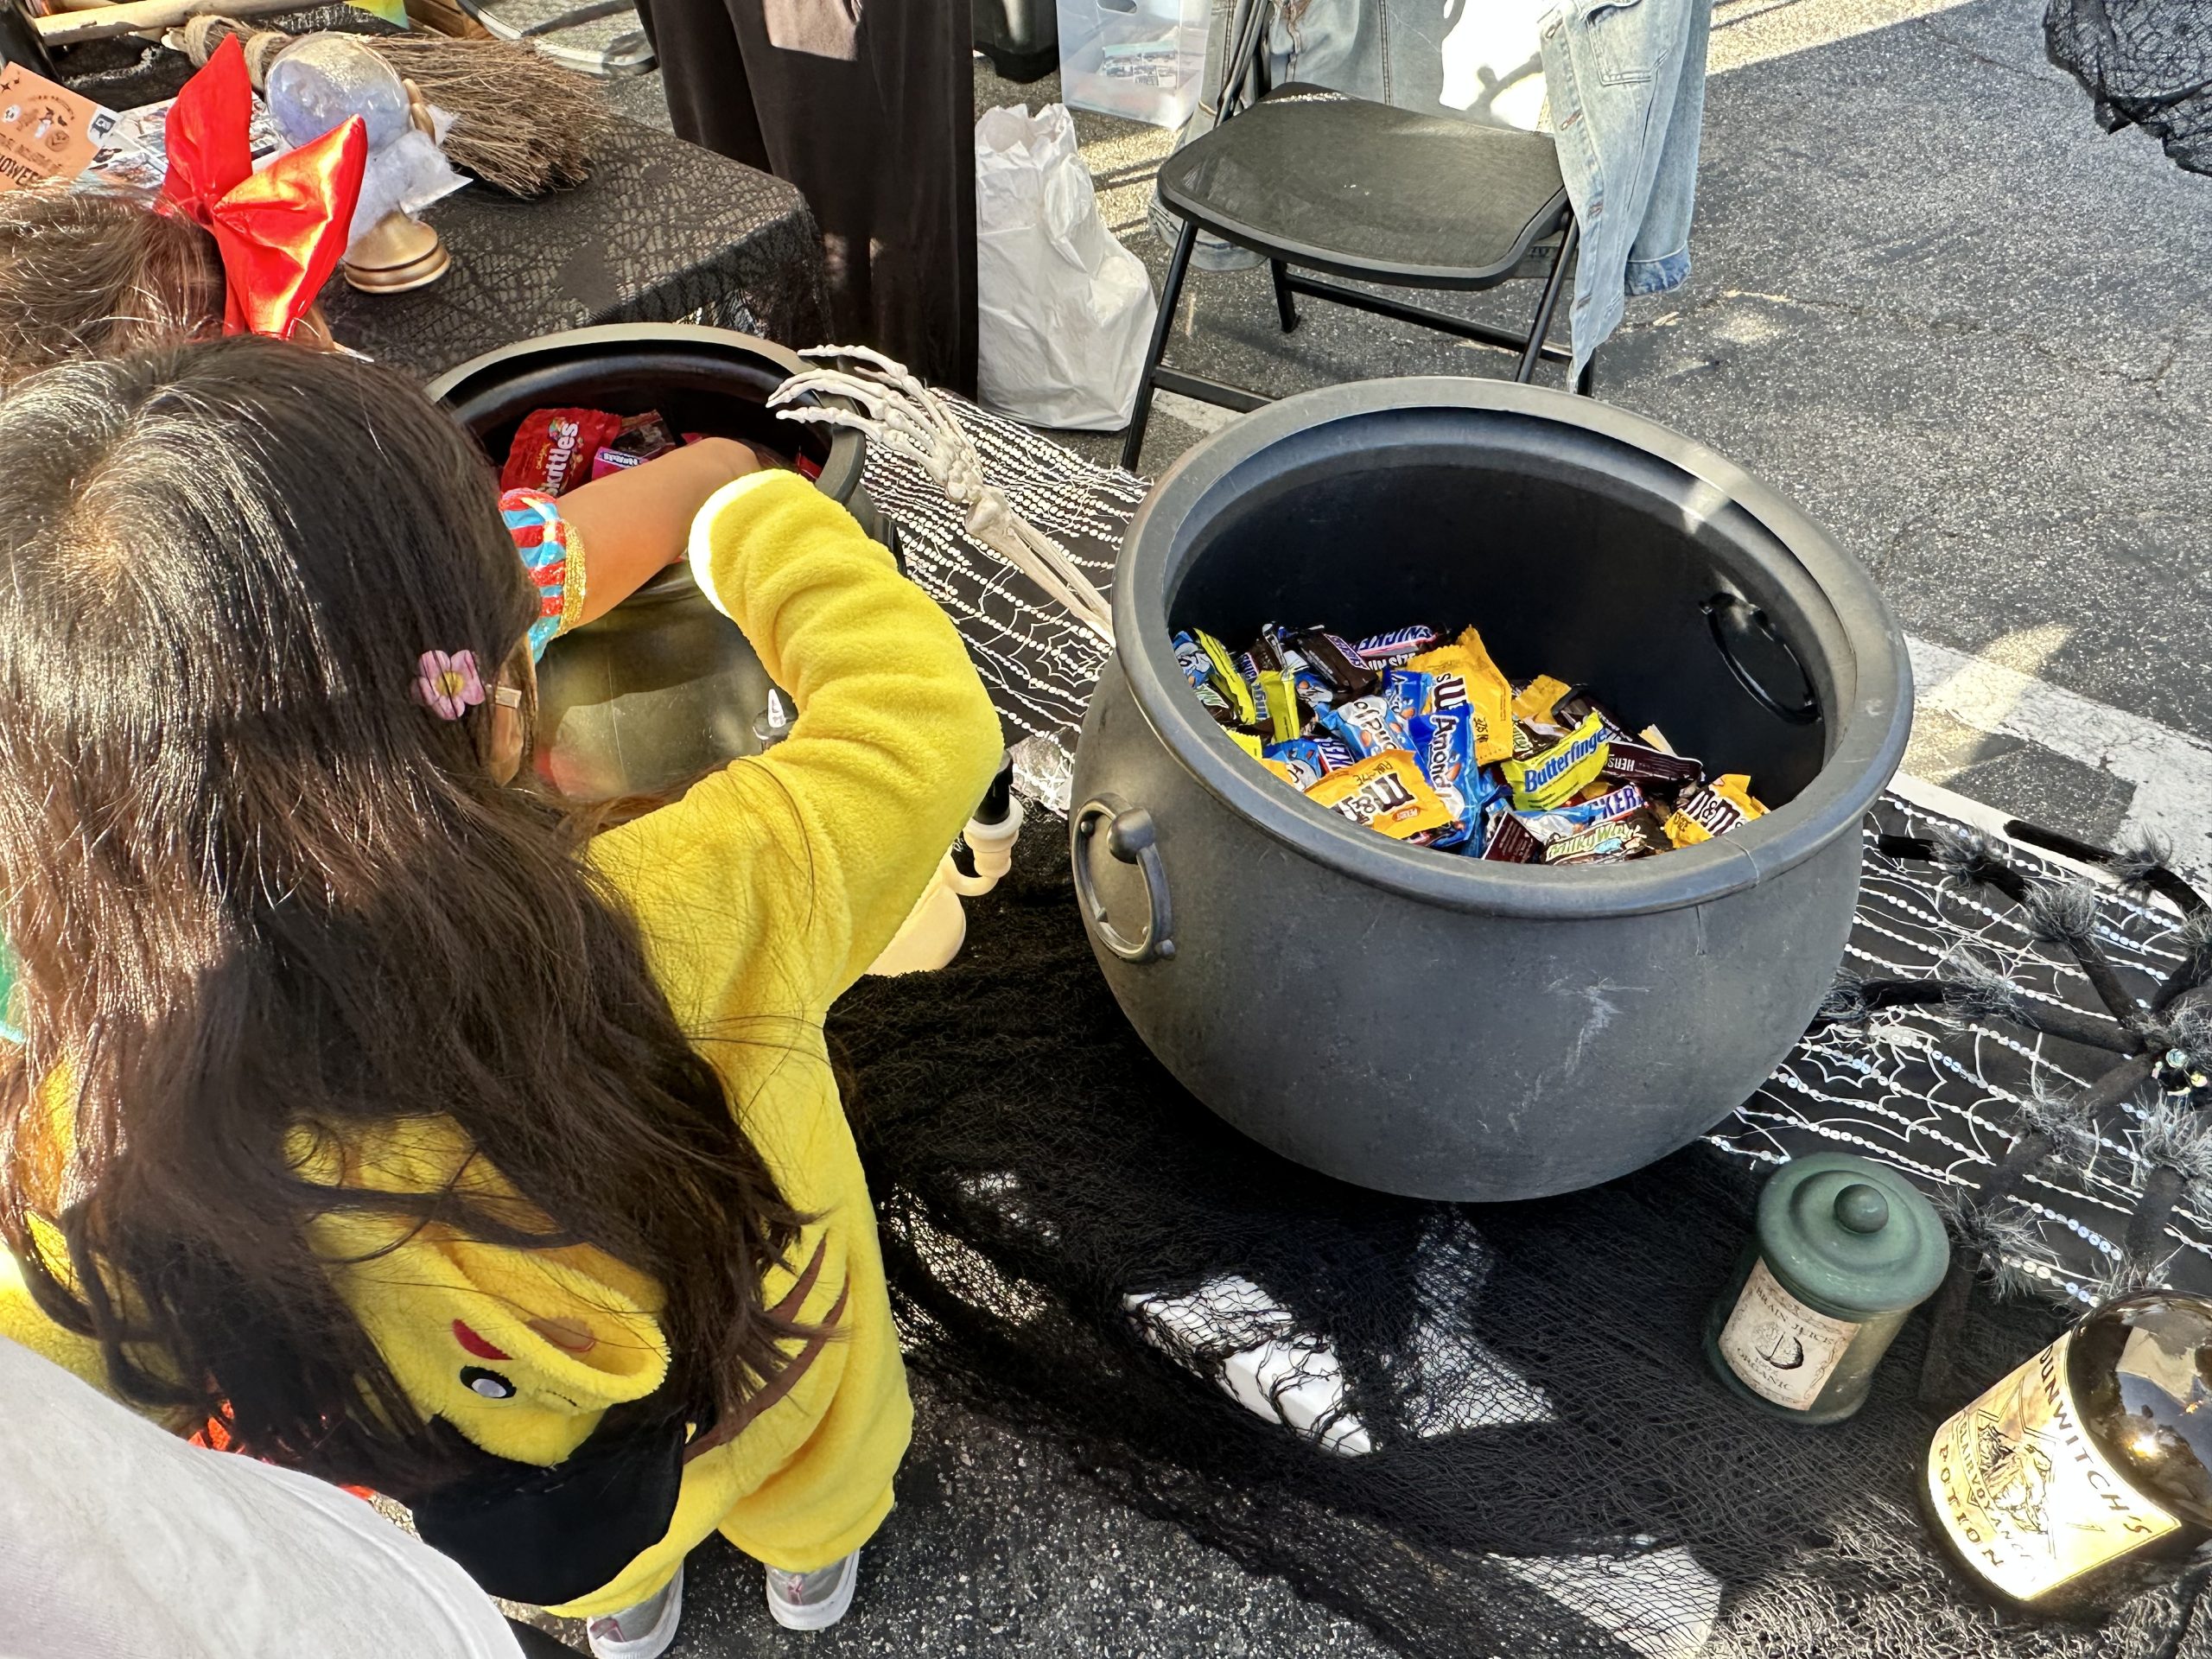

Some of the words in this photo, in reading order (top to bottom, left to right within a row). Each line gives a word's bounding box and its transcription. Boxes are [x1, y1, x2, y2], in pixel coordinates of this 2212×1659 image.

[1607, 758, 1636, 772] HERS
[1737, 1347, 1795, 1391] ORGANIC
[1939, 1444, 2005, 1568] POTION
